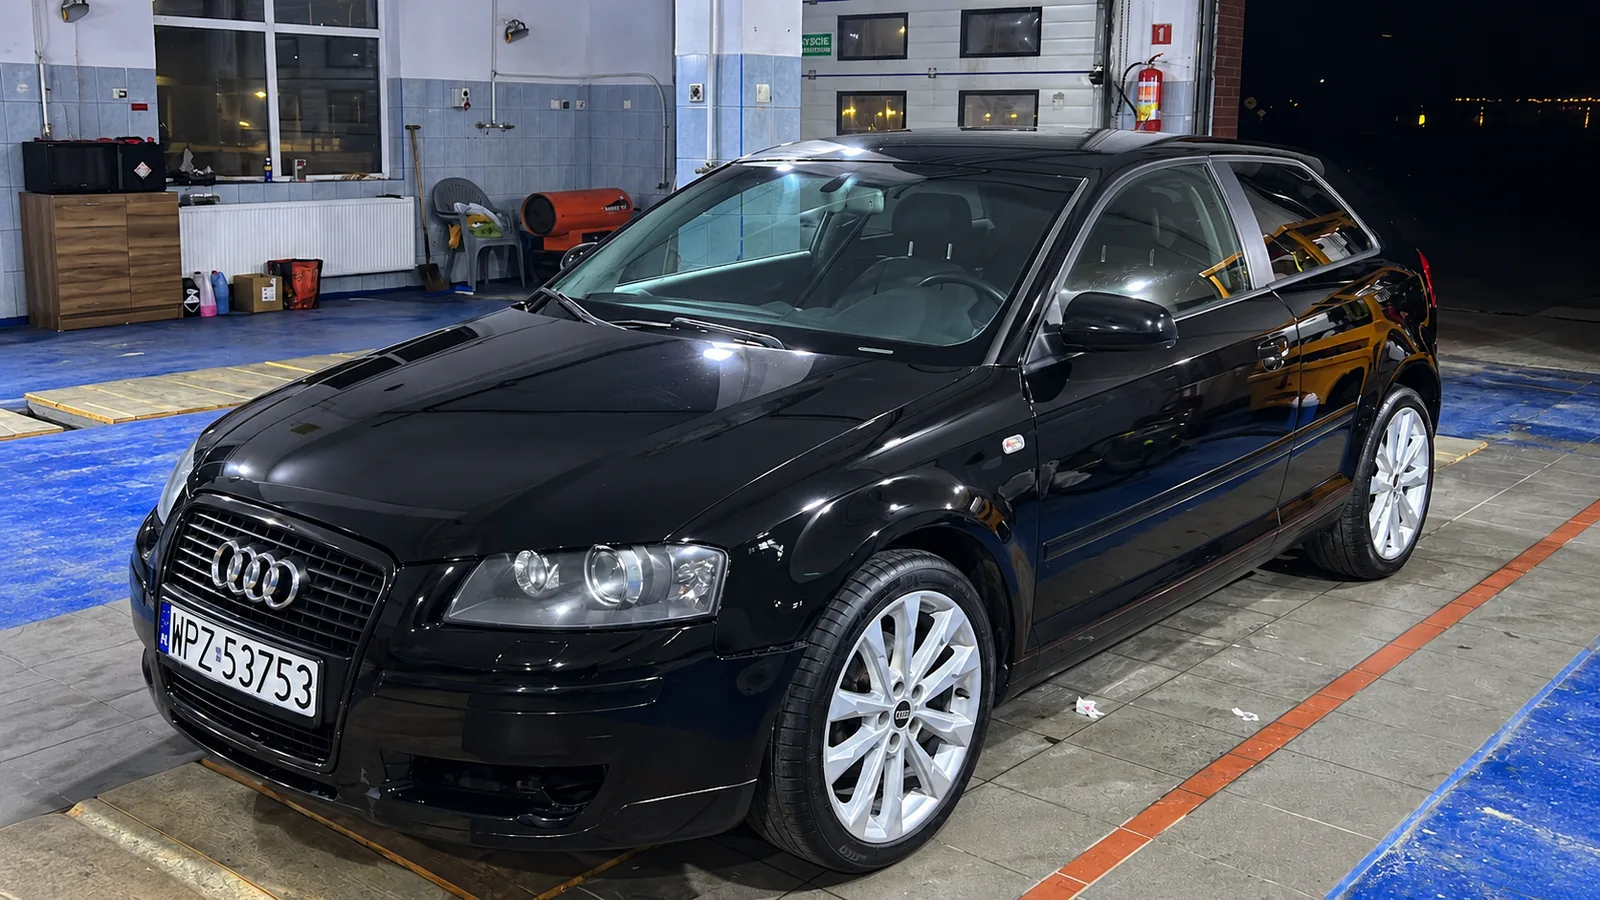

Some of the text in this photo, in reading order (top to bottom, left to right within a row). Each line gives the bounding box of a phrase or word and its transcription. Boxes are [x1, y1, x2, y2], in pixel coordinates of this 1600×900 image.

[802, 37, 829, 45] YSCIE
[1158, 27, 1164, 42] 1
[172, 612, 313, 710] WPZ 53753
